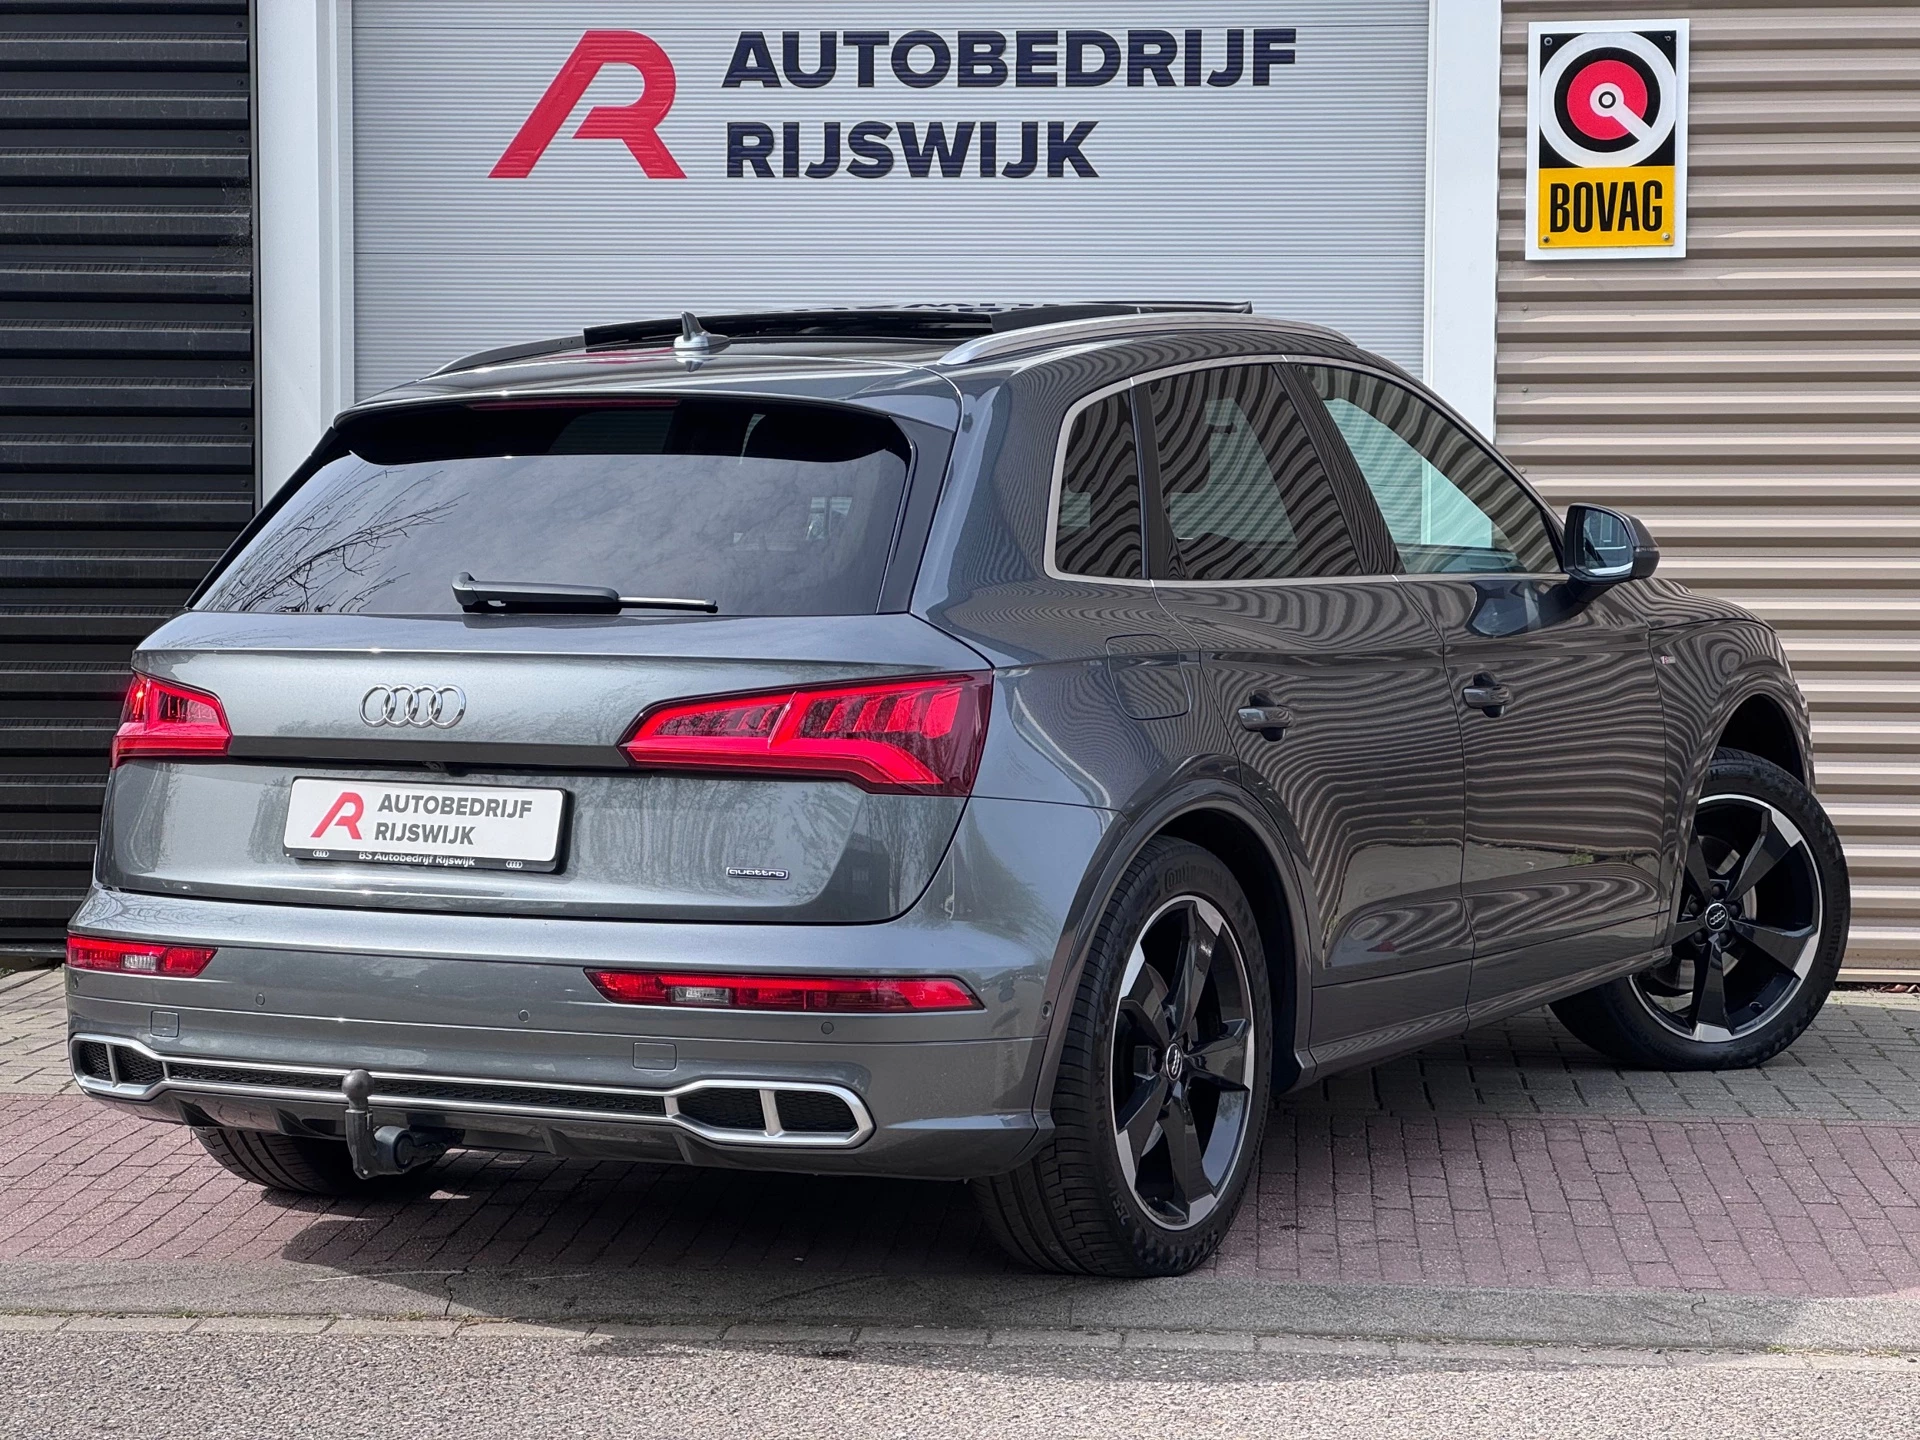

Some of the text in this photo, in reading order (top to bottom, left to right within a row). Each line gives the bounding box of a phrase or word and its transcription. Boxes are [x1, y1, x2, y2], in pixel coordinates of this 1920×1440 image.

[721, 27, 1297, 89] AUTOBEDRIJF
[727, 120, 1100, 179] RIJSWIJK
[1550, 180, 1663, 233] BOVAG
[377, 794, 533, 819] AUTOBEDRIJF
[374, 822, 476, 845] RIJSWIJK
[358, 851, 476, 868] BS Autobedrijf Rijswijk
[729, 868, 785, 877] quattro
